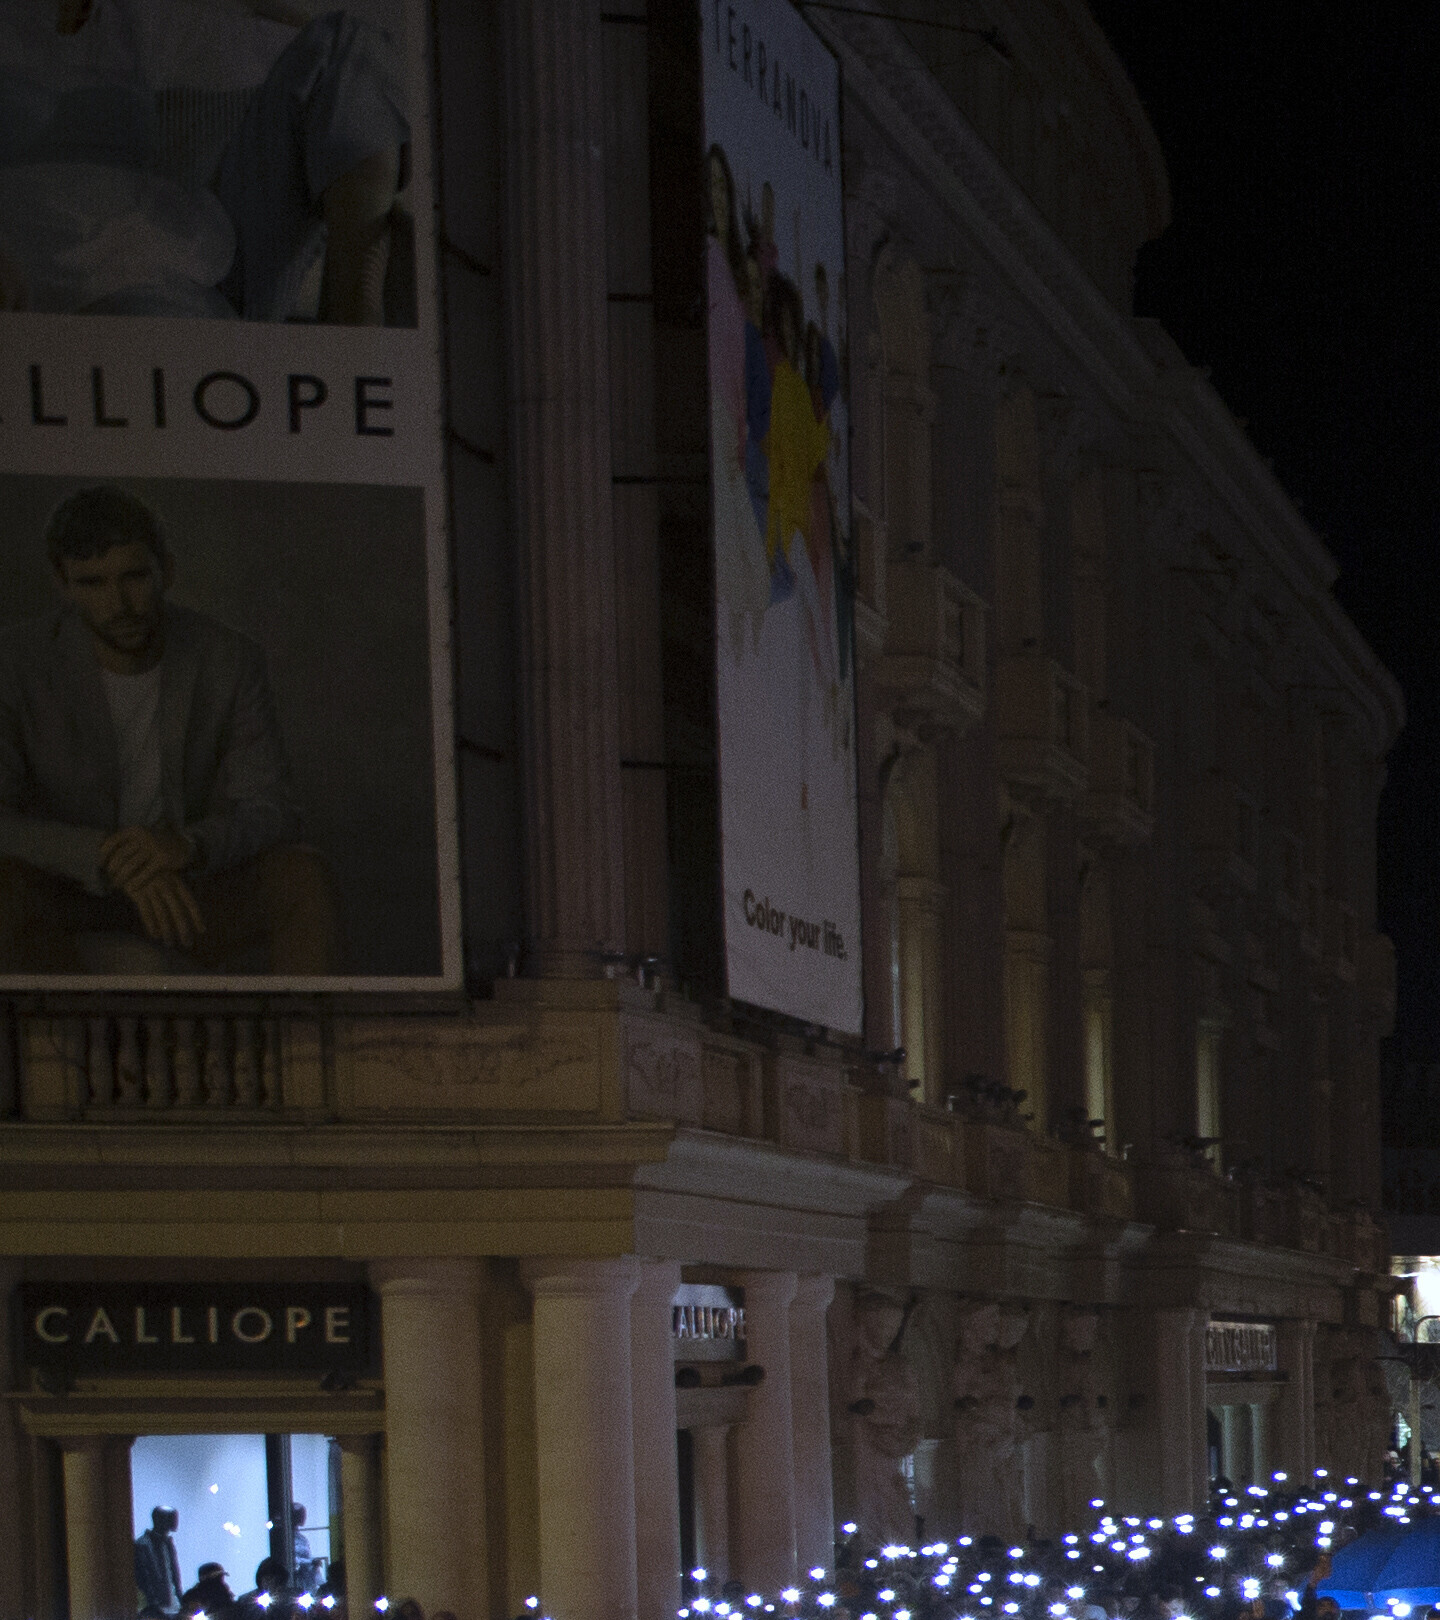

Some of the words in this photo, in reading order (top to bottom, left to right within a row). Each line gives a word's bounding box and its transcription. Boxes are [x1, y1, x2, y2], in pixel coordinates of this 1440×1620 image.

[0, 363, 395, 437] LLIOPE
[743, 888, 786, 938] Color
[788, 914, 821, 953] your
[33, 1305, 351, 1344] CALLIOPE
[672, 1305, 747, 1340] ALLIOPE
